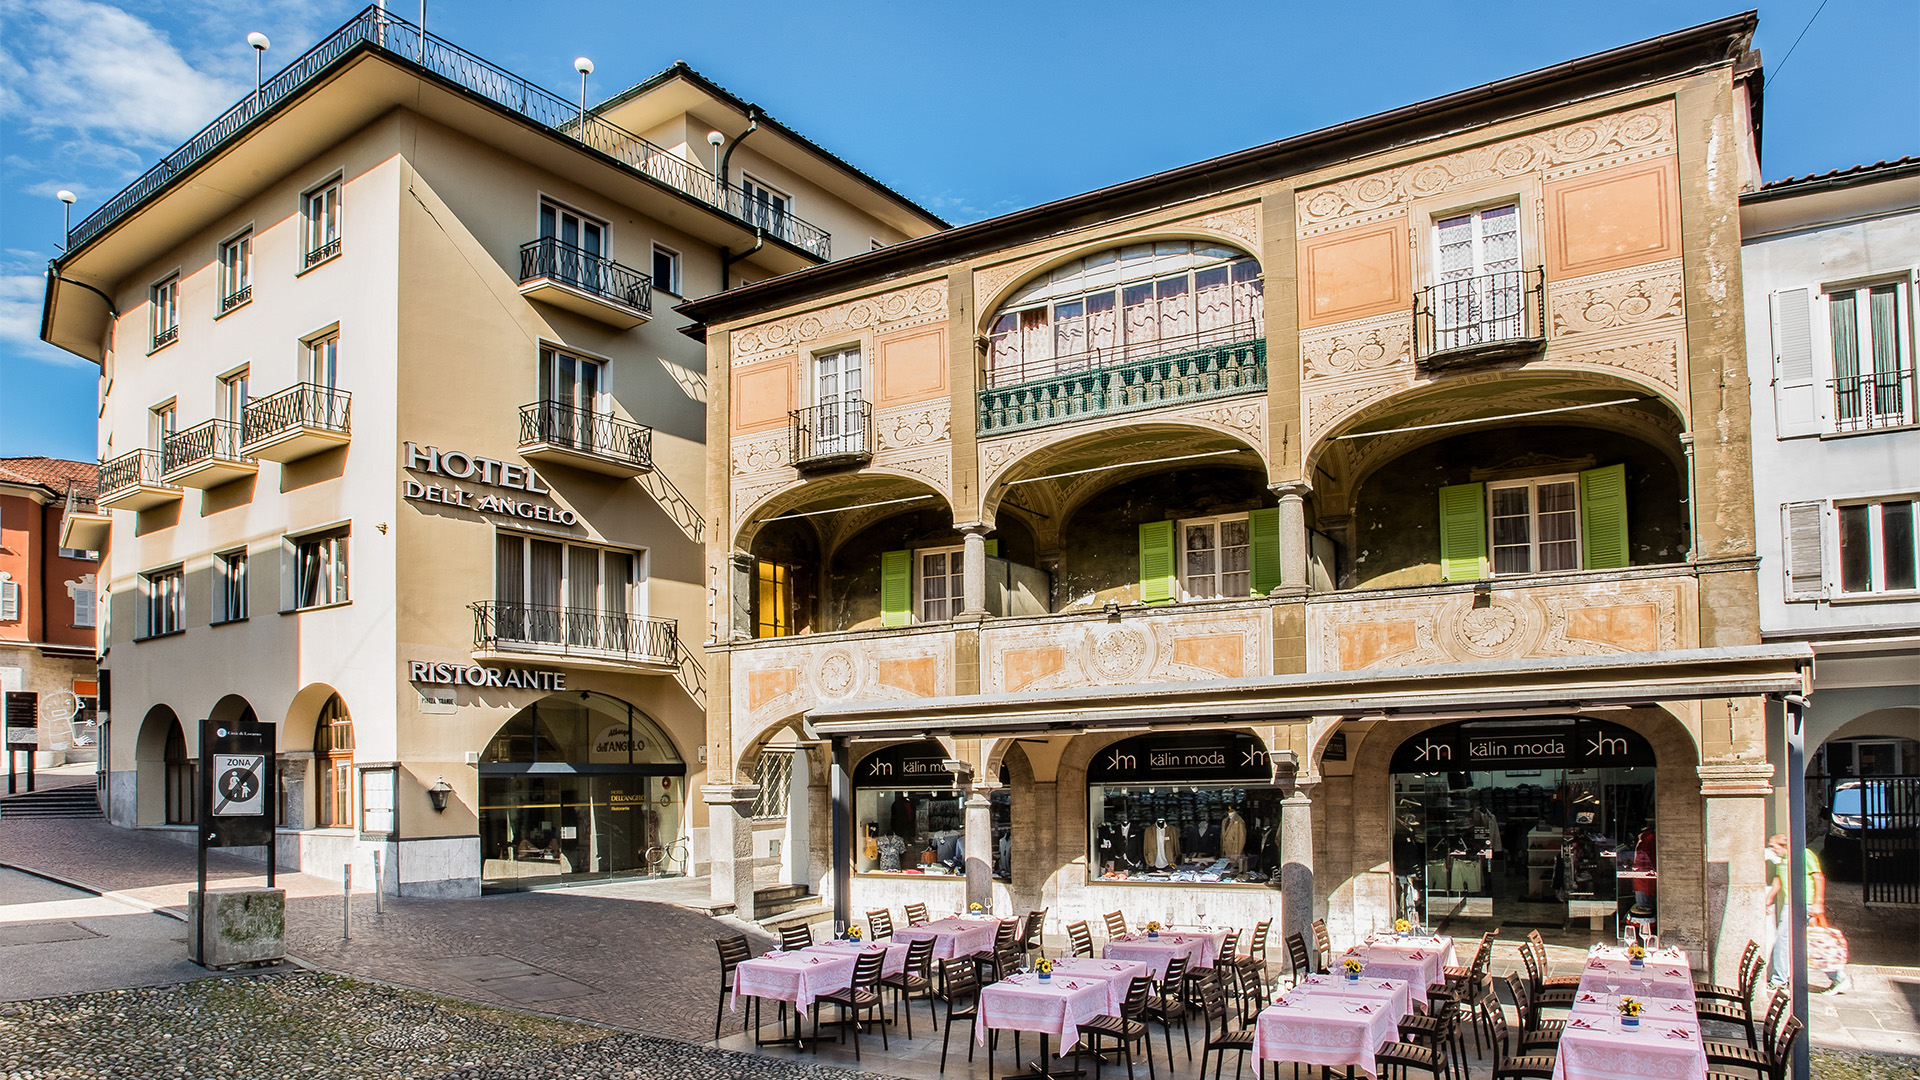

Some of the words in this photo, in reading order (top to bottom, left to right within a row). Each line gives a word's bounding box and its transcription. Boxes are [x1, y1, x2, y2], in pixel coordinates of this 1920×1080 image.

[403, 441, 549, 495] HOTEL
[477, 494, 577, 526] ANGELO
[408, 660, 567, 691] RISTORANTE
[596, 740, 645, 752] dell'ANGLO
[1469, 741, 1507, 757] kälin
[1513, 739, 1566, 755] moda
[227, 759, 252, 767] ZONA
[1150, 753, 1180, 766] kälin
[1184, 751, 1225, 765] moda
[902, 761, 927, 773] kälin
